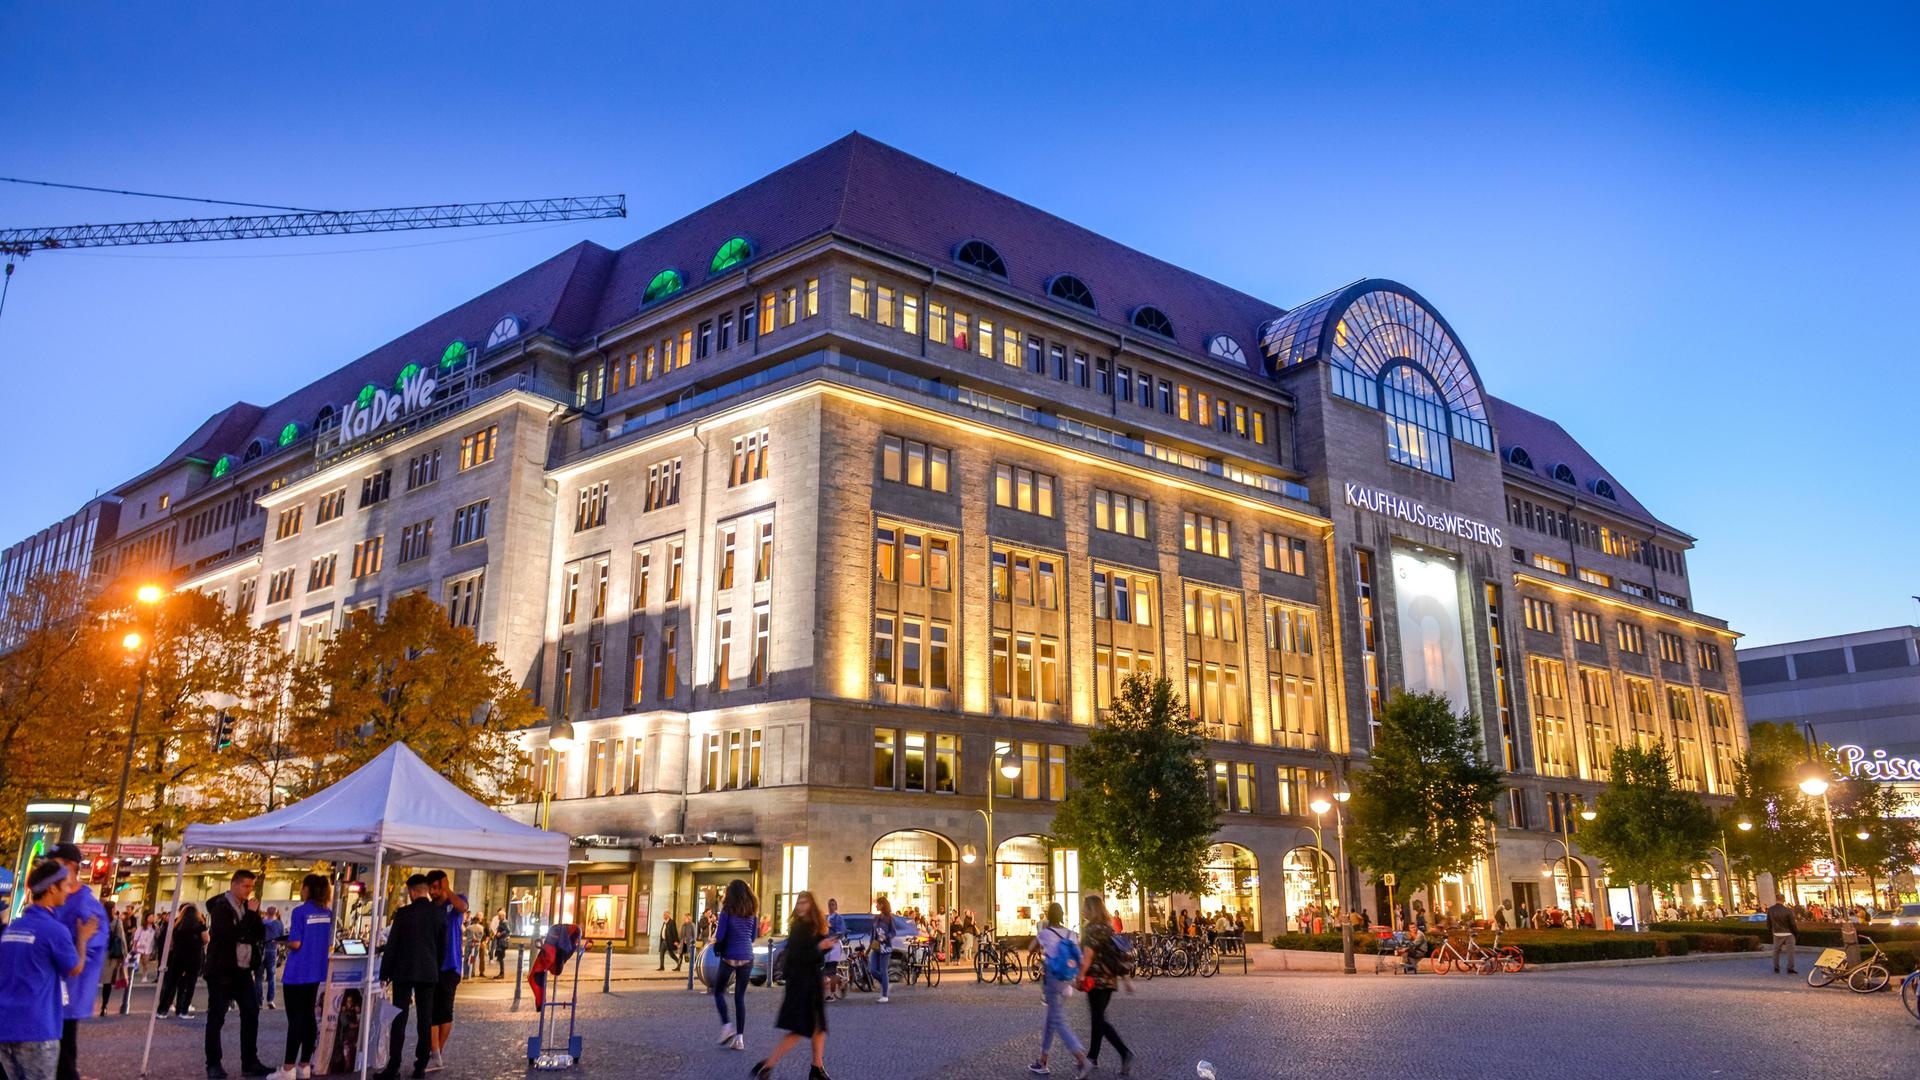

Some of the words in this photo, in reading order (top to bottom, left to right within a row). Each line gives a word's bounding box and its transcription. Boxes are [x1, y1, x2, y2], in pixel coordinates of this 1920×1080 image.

[339, 367, 436, 445] KaDeWe
[1345, 483, 1426, 525] KAUFHAUS
[1427, 514, 1445, 531] DES
[1443, 512, 1503, 548] WESTENS
